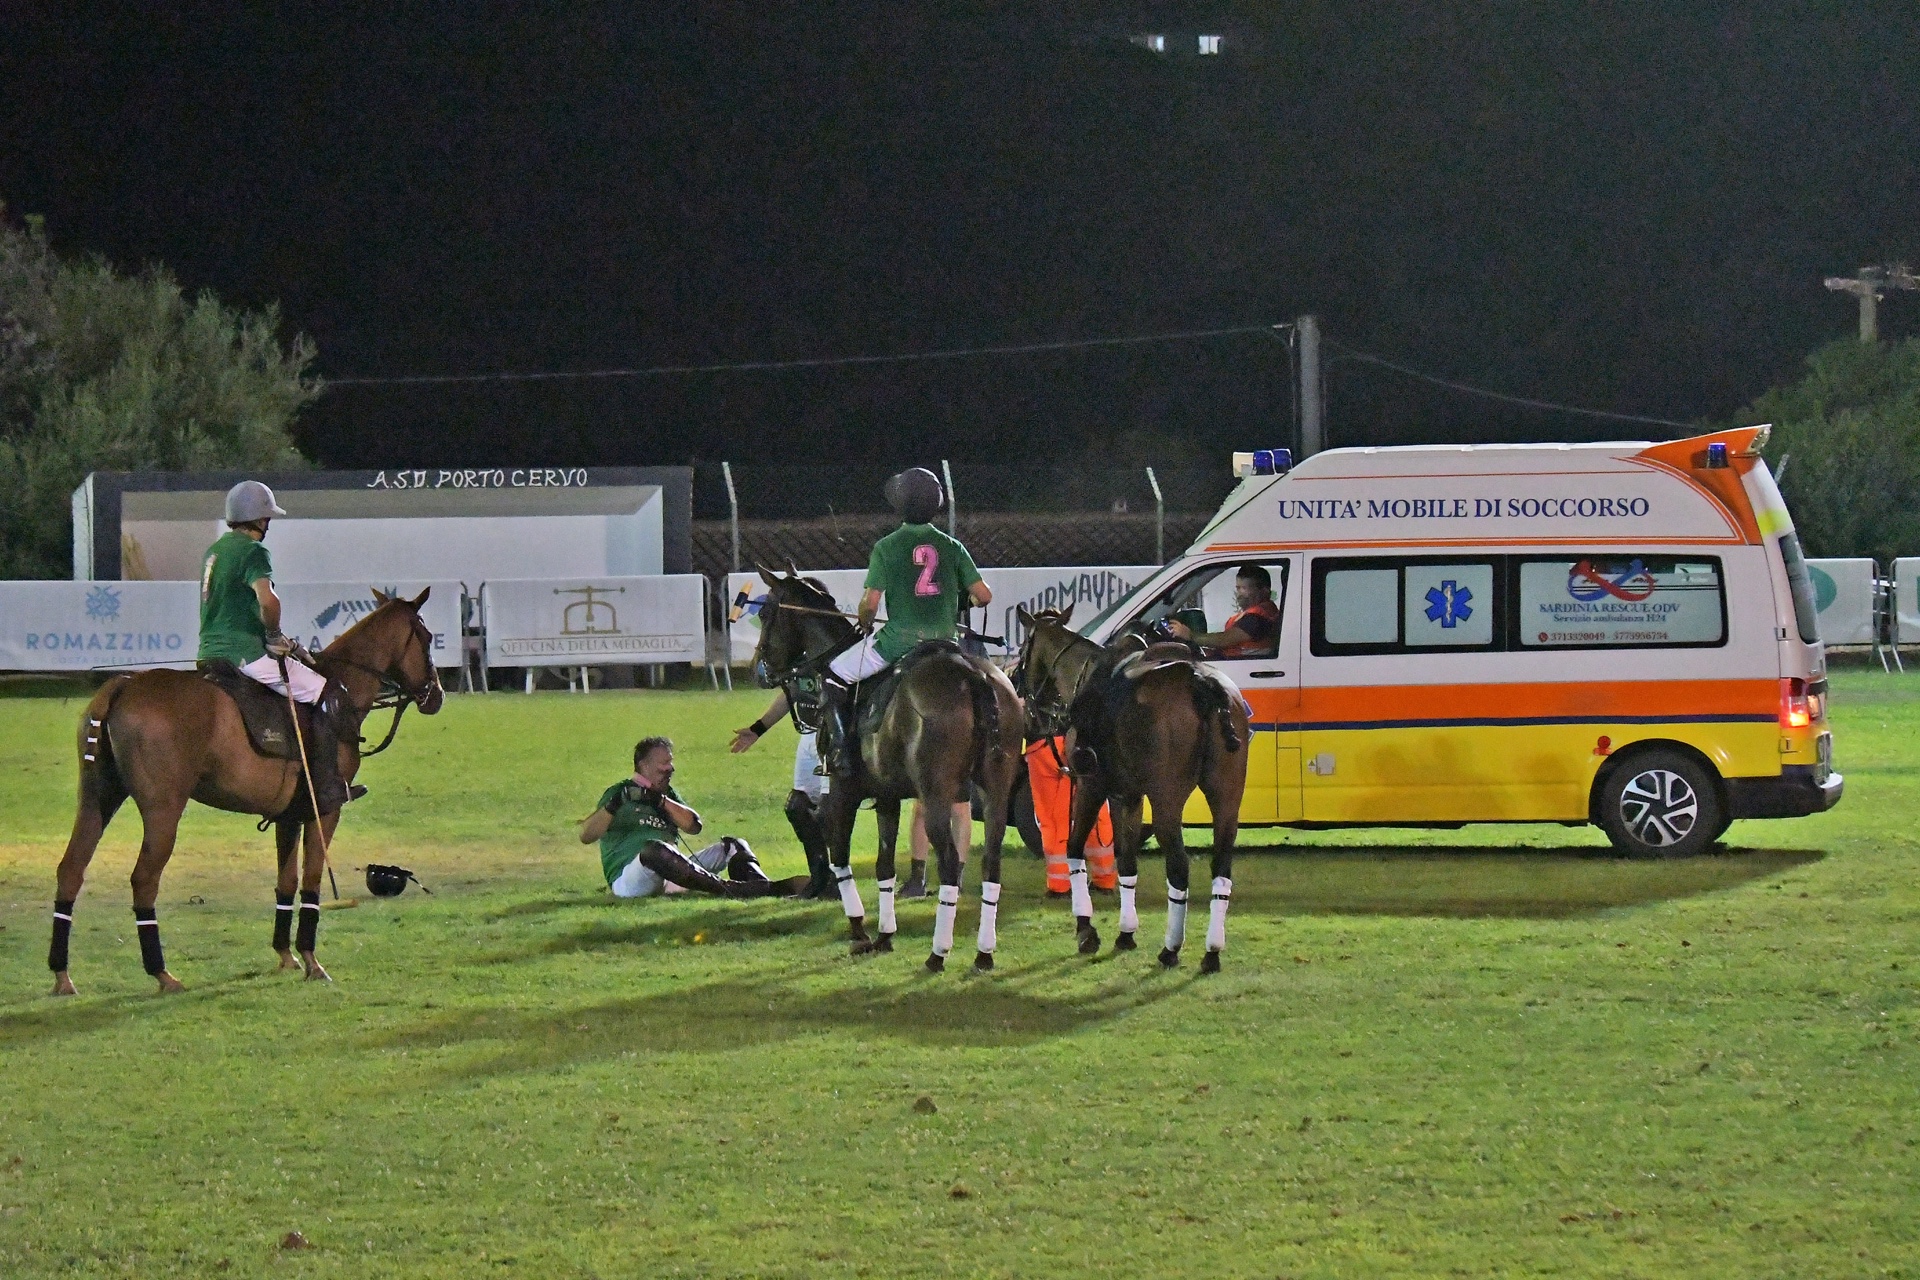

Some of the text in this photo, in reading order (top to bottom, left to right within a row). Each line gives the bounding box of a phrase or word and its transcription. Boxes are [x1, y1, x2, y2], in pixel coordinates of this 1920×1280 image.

[367, 468, 588, 489] A.S.D. PORTO CERVO
[1367, 499, 1468, 519] MOBILE
[1474, 498, 1502, 518] DI
[1507, 497, 1650, 518] SOCCORSO
[913, 544, 941, 597] 2
[1539, 603, 1598, 613] SARDINIA
[1553, 613, 1666, 622] Servizio ambulanza H24
[26, 633, 182, 650] ROMAZZINO
[568, 639, 608, 652] DELLA
[612, 637, 682, 651] MEDAGLIA
